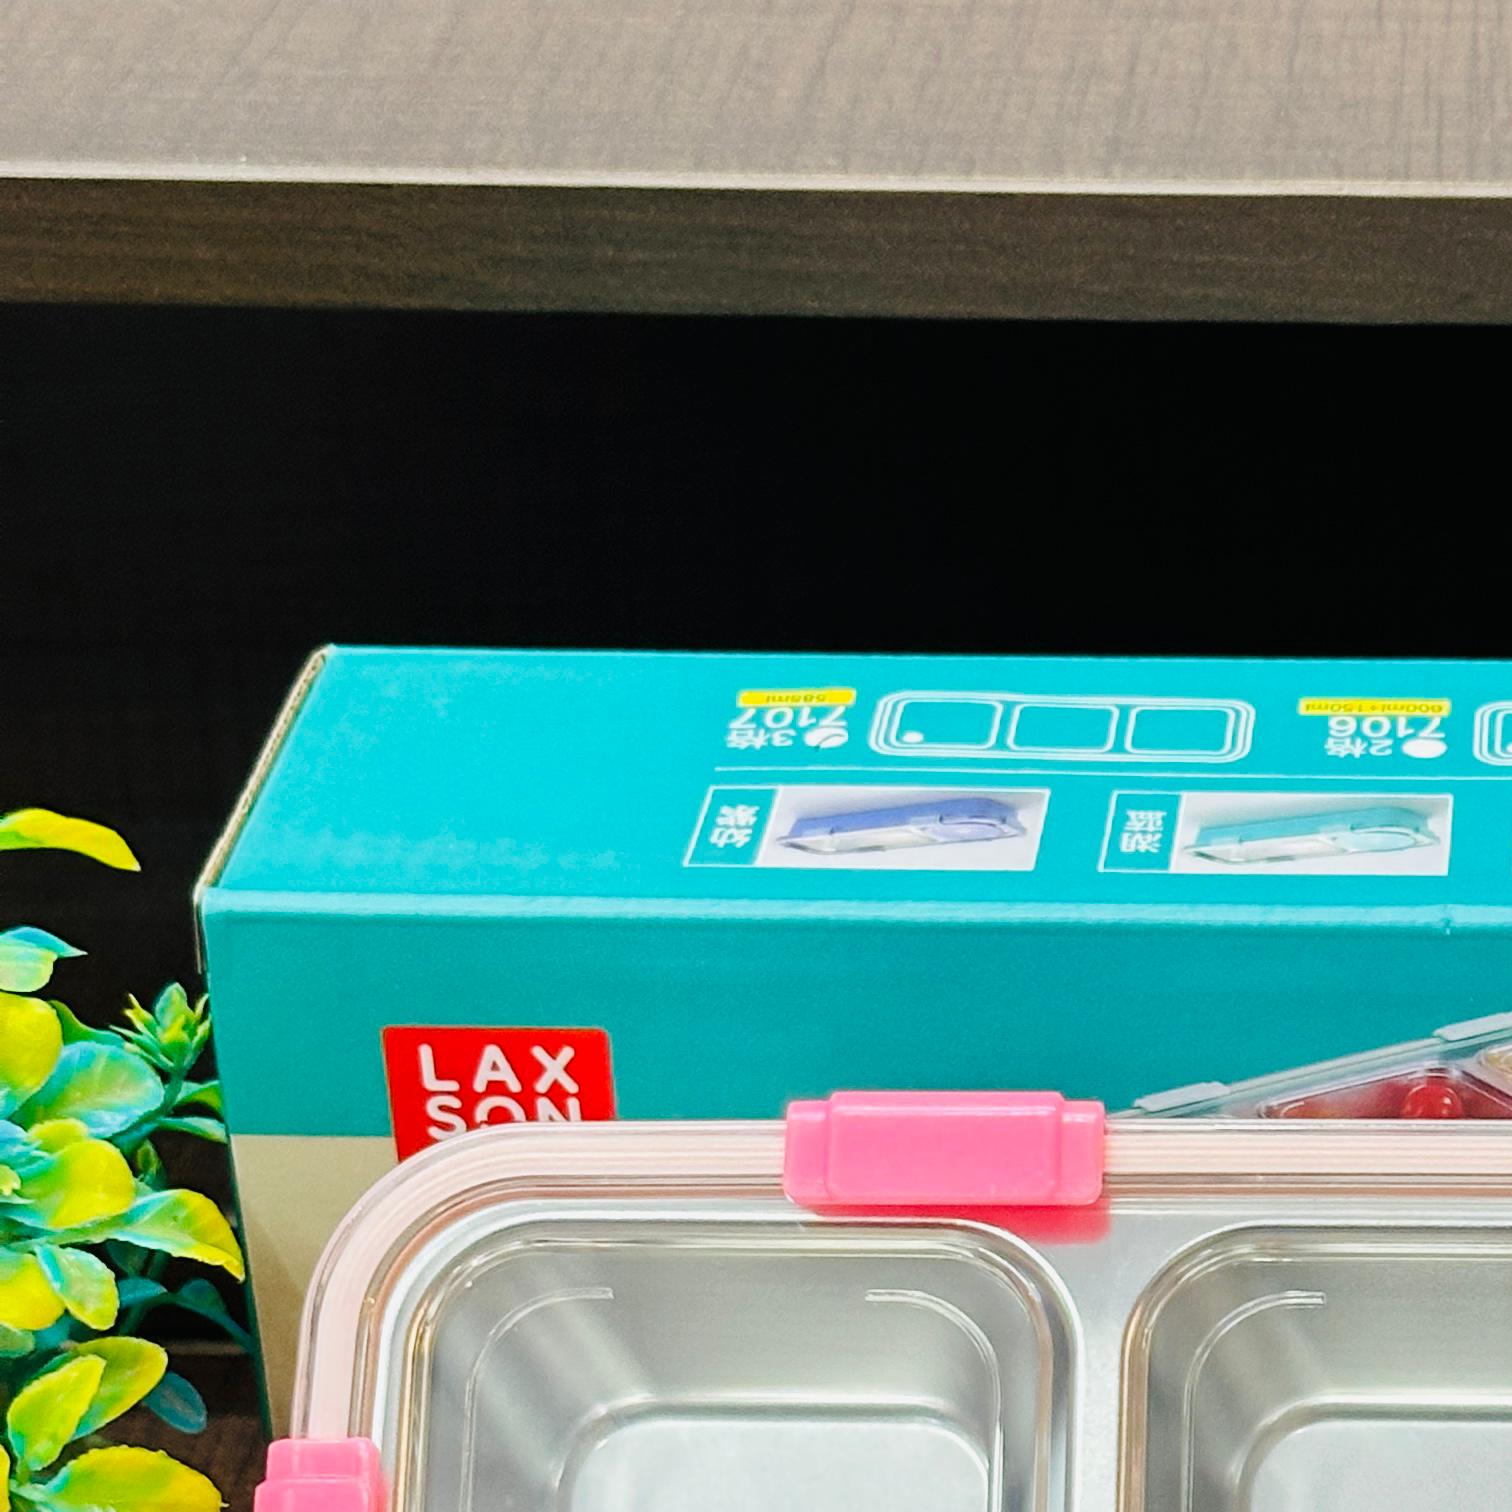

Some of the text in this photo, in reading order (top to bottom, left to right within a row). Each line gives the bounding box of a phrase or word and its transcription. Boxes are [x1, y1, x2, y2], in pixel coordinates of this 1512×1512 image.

[729, 707, 848, 728] 7107
[1305, 702, 1443, 714] 600ml+150ml
[1327, 716, 1447, 737] 7106
[725, 728, 797, 749] 3格
[1324, 737, 1394, 759] 2格
[1121, 810, 1167, 853] 湖蓝
[417, 1043, 580, 1094] LAX
